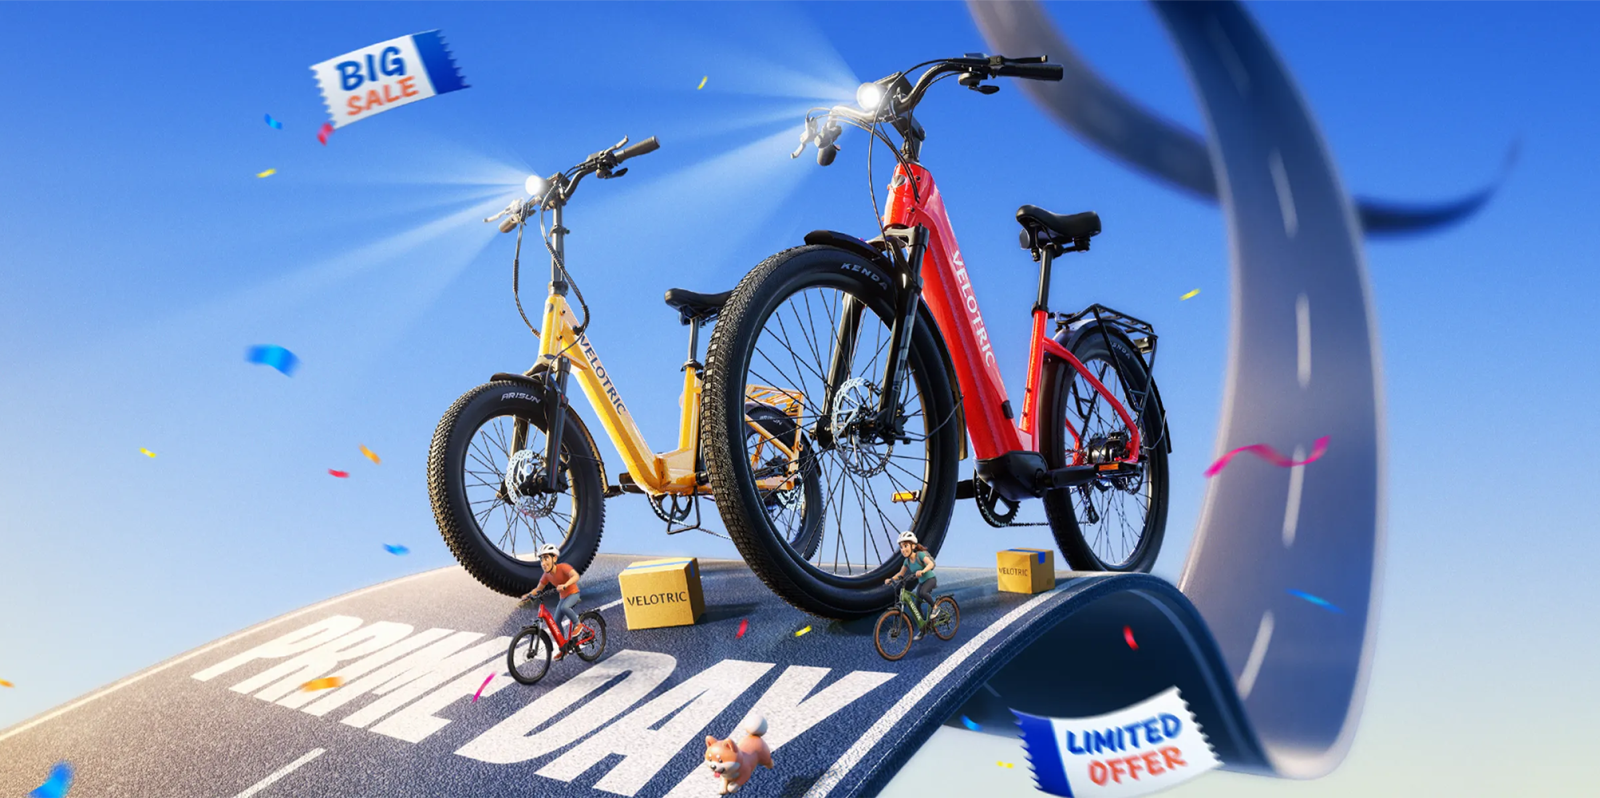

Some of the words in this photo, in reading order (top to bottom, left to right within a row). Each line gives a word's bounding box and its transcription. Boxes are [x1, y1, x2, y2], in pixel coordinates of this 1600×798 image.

[335, 46, 406, 91] BIG
[347, 75, 419, 116] SALE
[841, 262, 888, 290] KENDA
[952, 250, 996, 367] VELOTRIC
[1112, 342, 1131, 360] ENDA
[579, 335, 626, 416] VELOTRIC
[501, 392, 541, 405] ARISUN
[998, 567, 1029, 577] VELOTRIC
[627, 591, 688, 607] VELOTRIC
[190, 613, 587, 744] PRIME
[454, 648, 899, 798] DAY
[1066, 712, 1183, 755] LIMITED
[1087, 746, 1188, 787] OFFER
